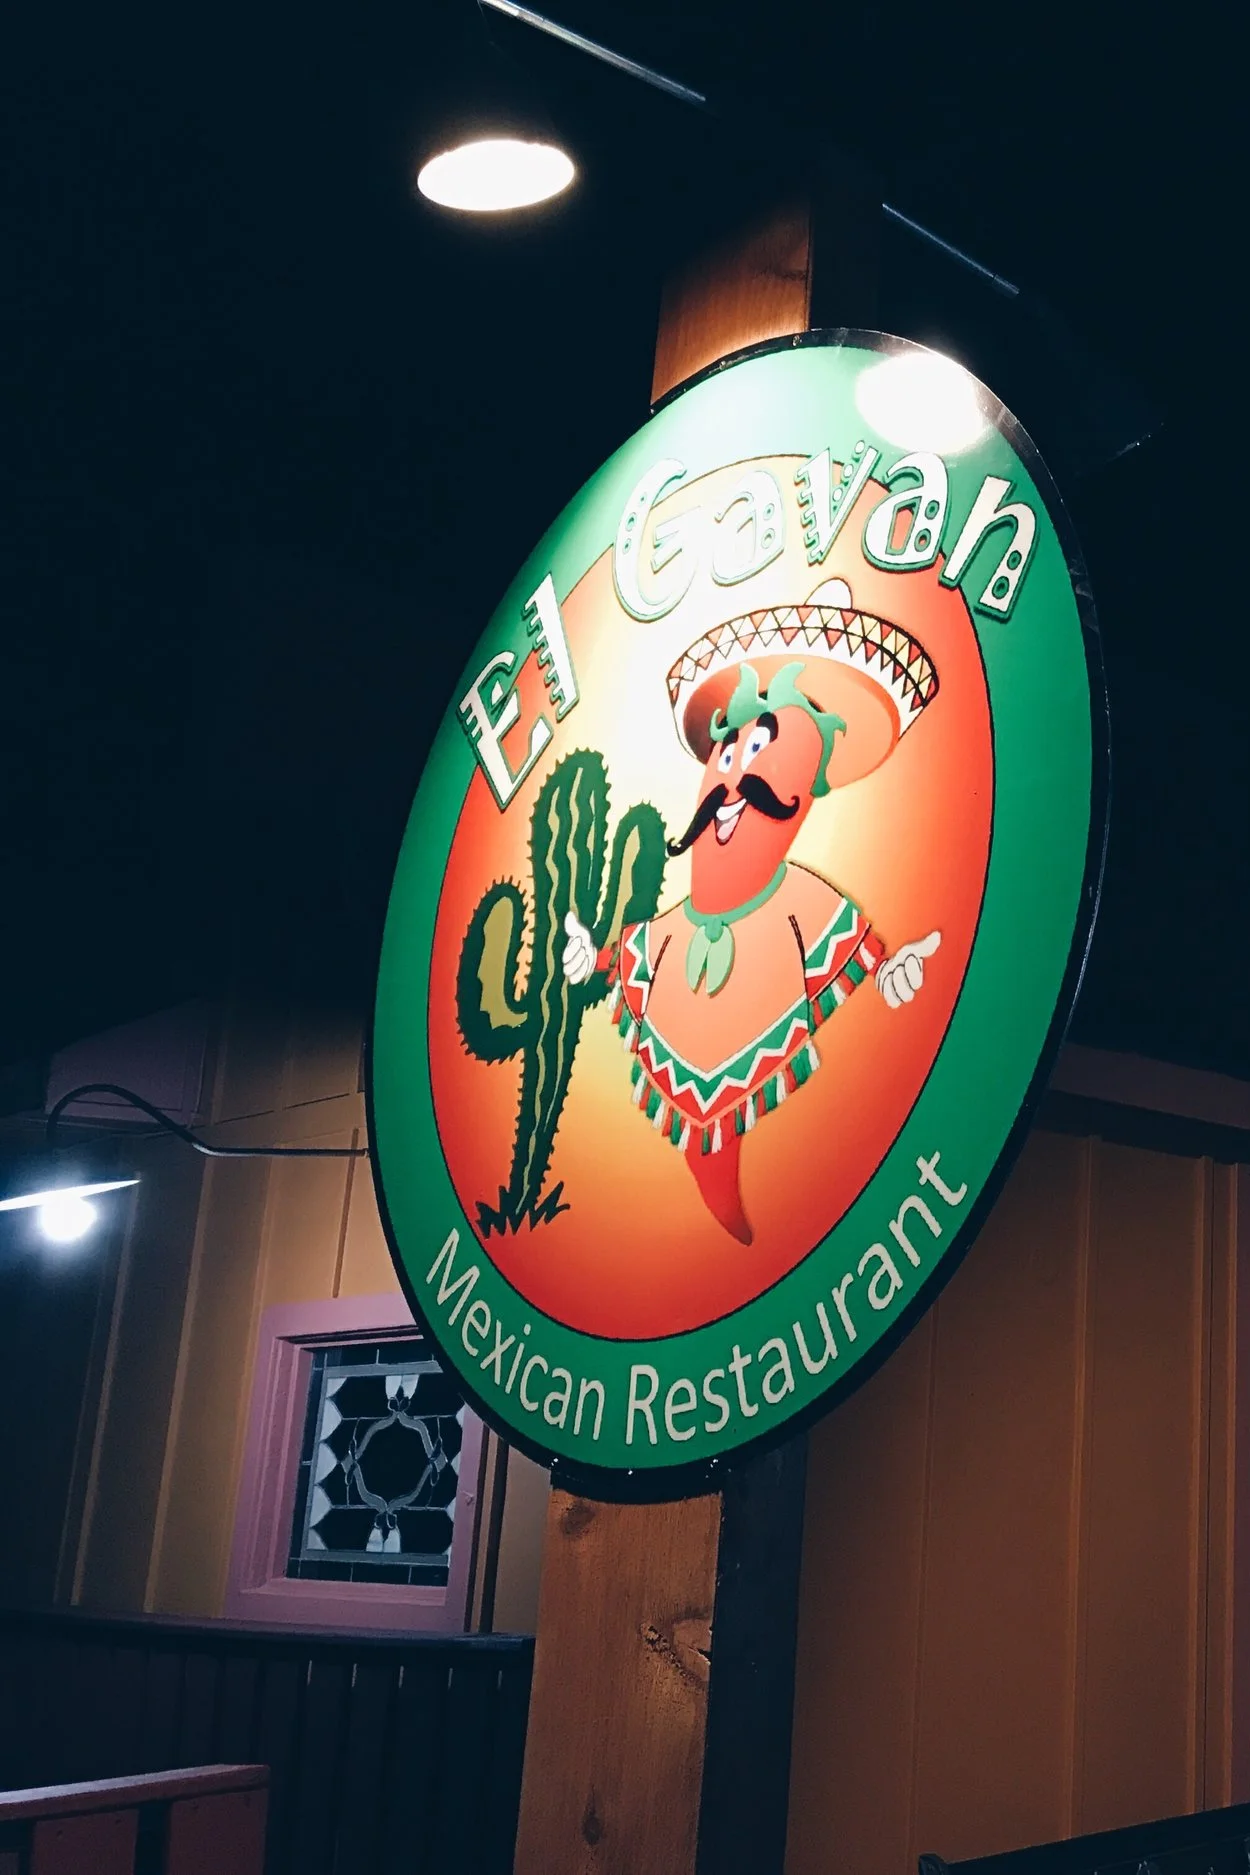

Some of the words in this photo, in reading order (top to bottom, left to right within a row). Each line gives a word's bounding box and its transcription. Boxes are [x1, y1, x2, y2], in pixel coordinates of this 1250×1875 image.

[457, 573, 580, 812] El
[612, 440, 1038, 623] Gavan
[425, 1228, 606, 1441] Mexican
[625, 1150, 968, 1446] Restaurant
